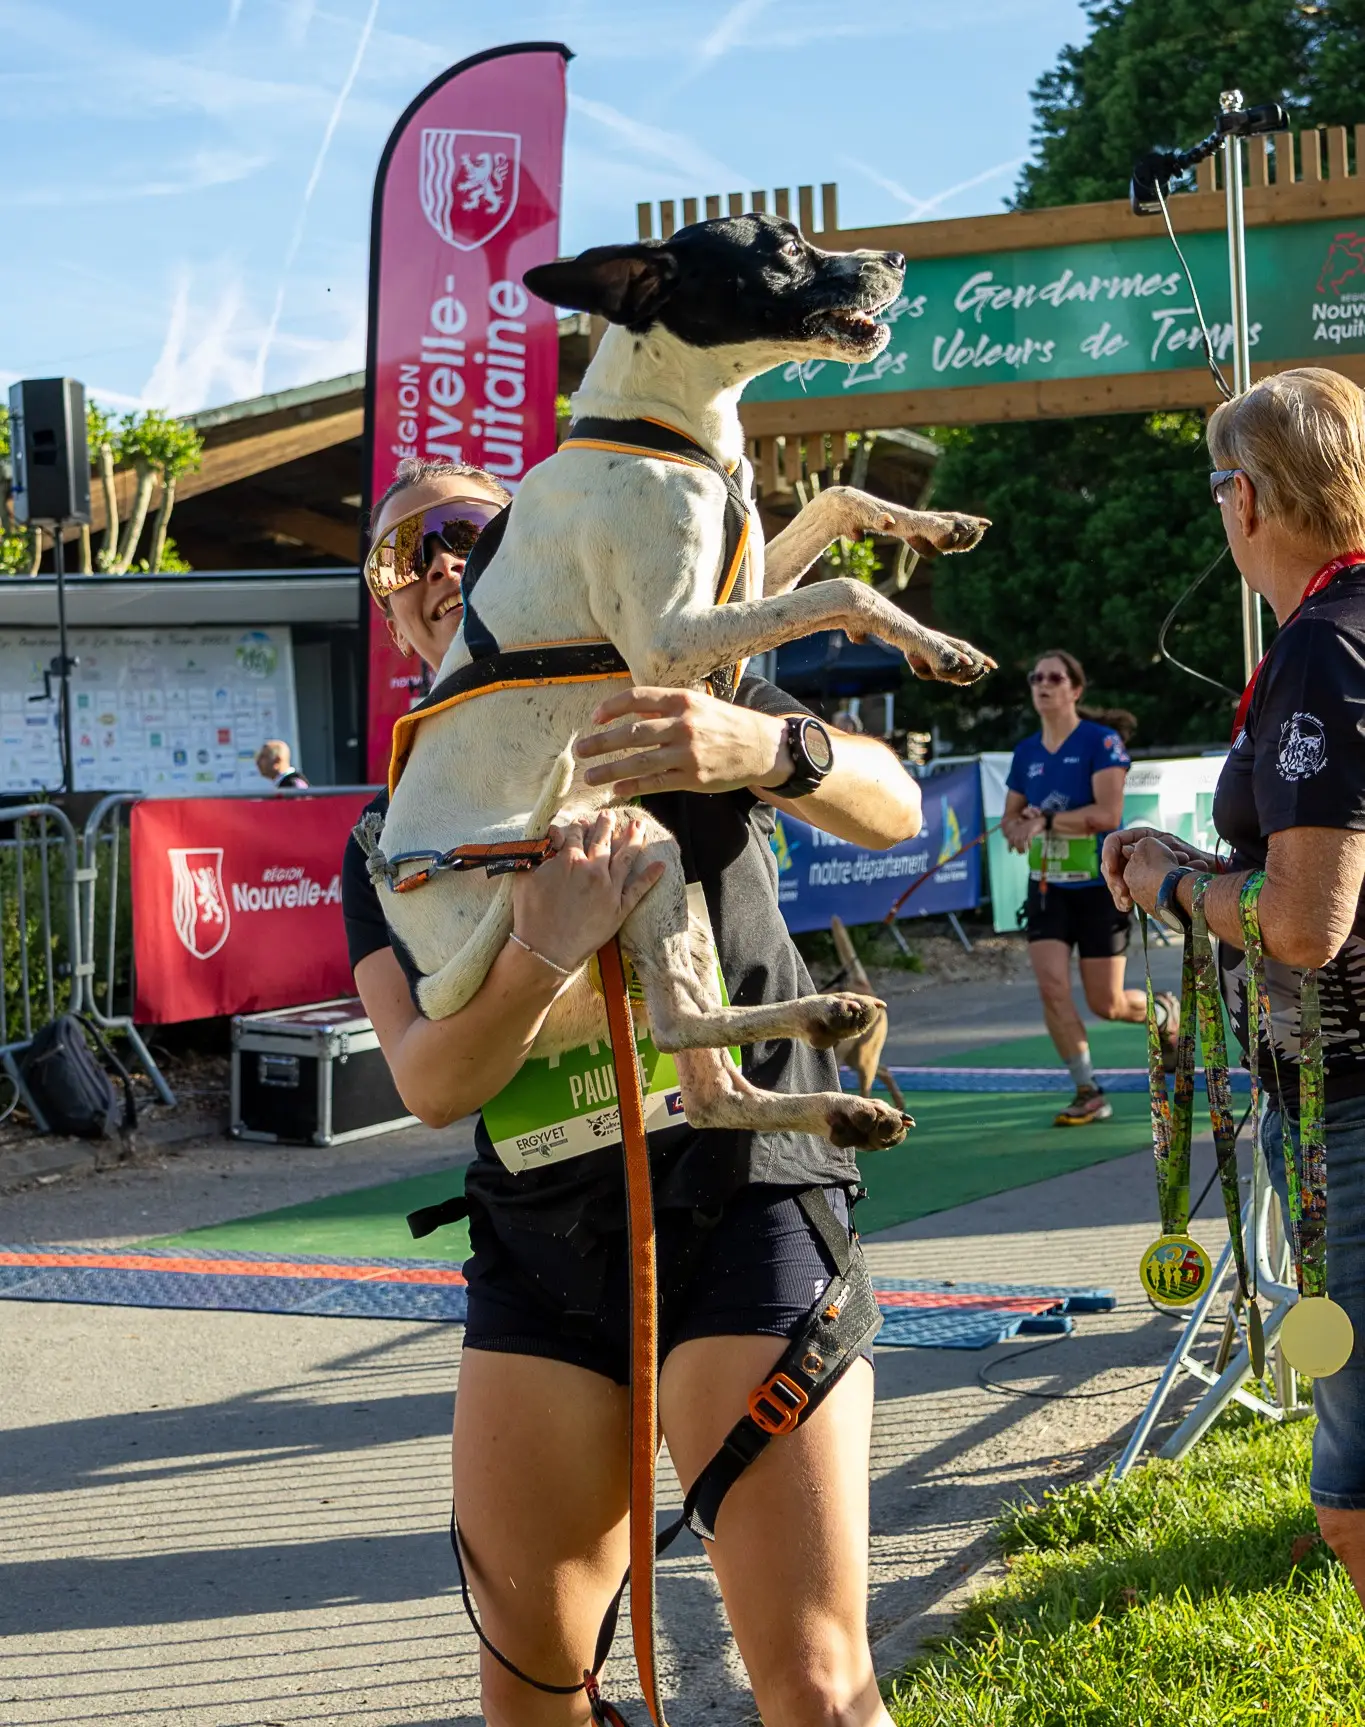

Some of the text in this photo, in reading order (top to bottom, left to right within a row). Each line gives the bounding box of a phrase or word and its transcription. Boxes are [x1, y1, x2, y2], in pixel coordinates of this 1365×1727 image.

[873, 269, 1182, 323] es Gendarmes
[1312, 303, 1365, 320] Nouv
[1313, 318, 1365, 344] Aquit
[420, 274, 468, 464] uvelle-
[842, 352, 908, 389] Les
[932, 328, 1055, 372] Voleurs
[1080, 321, 1129, 360] de
[469, 280, 529, 494] uitaine
[391, 364, 421, 458] ÉGION
[262, 866, 306, 882] RÉGION
[809, 858, 852, 887] notre
[852, 850, 930, 886] département
[231, 874, 342, 912] Nouvelle-A
[516, 1126, 565, 1151] ERGYVET
